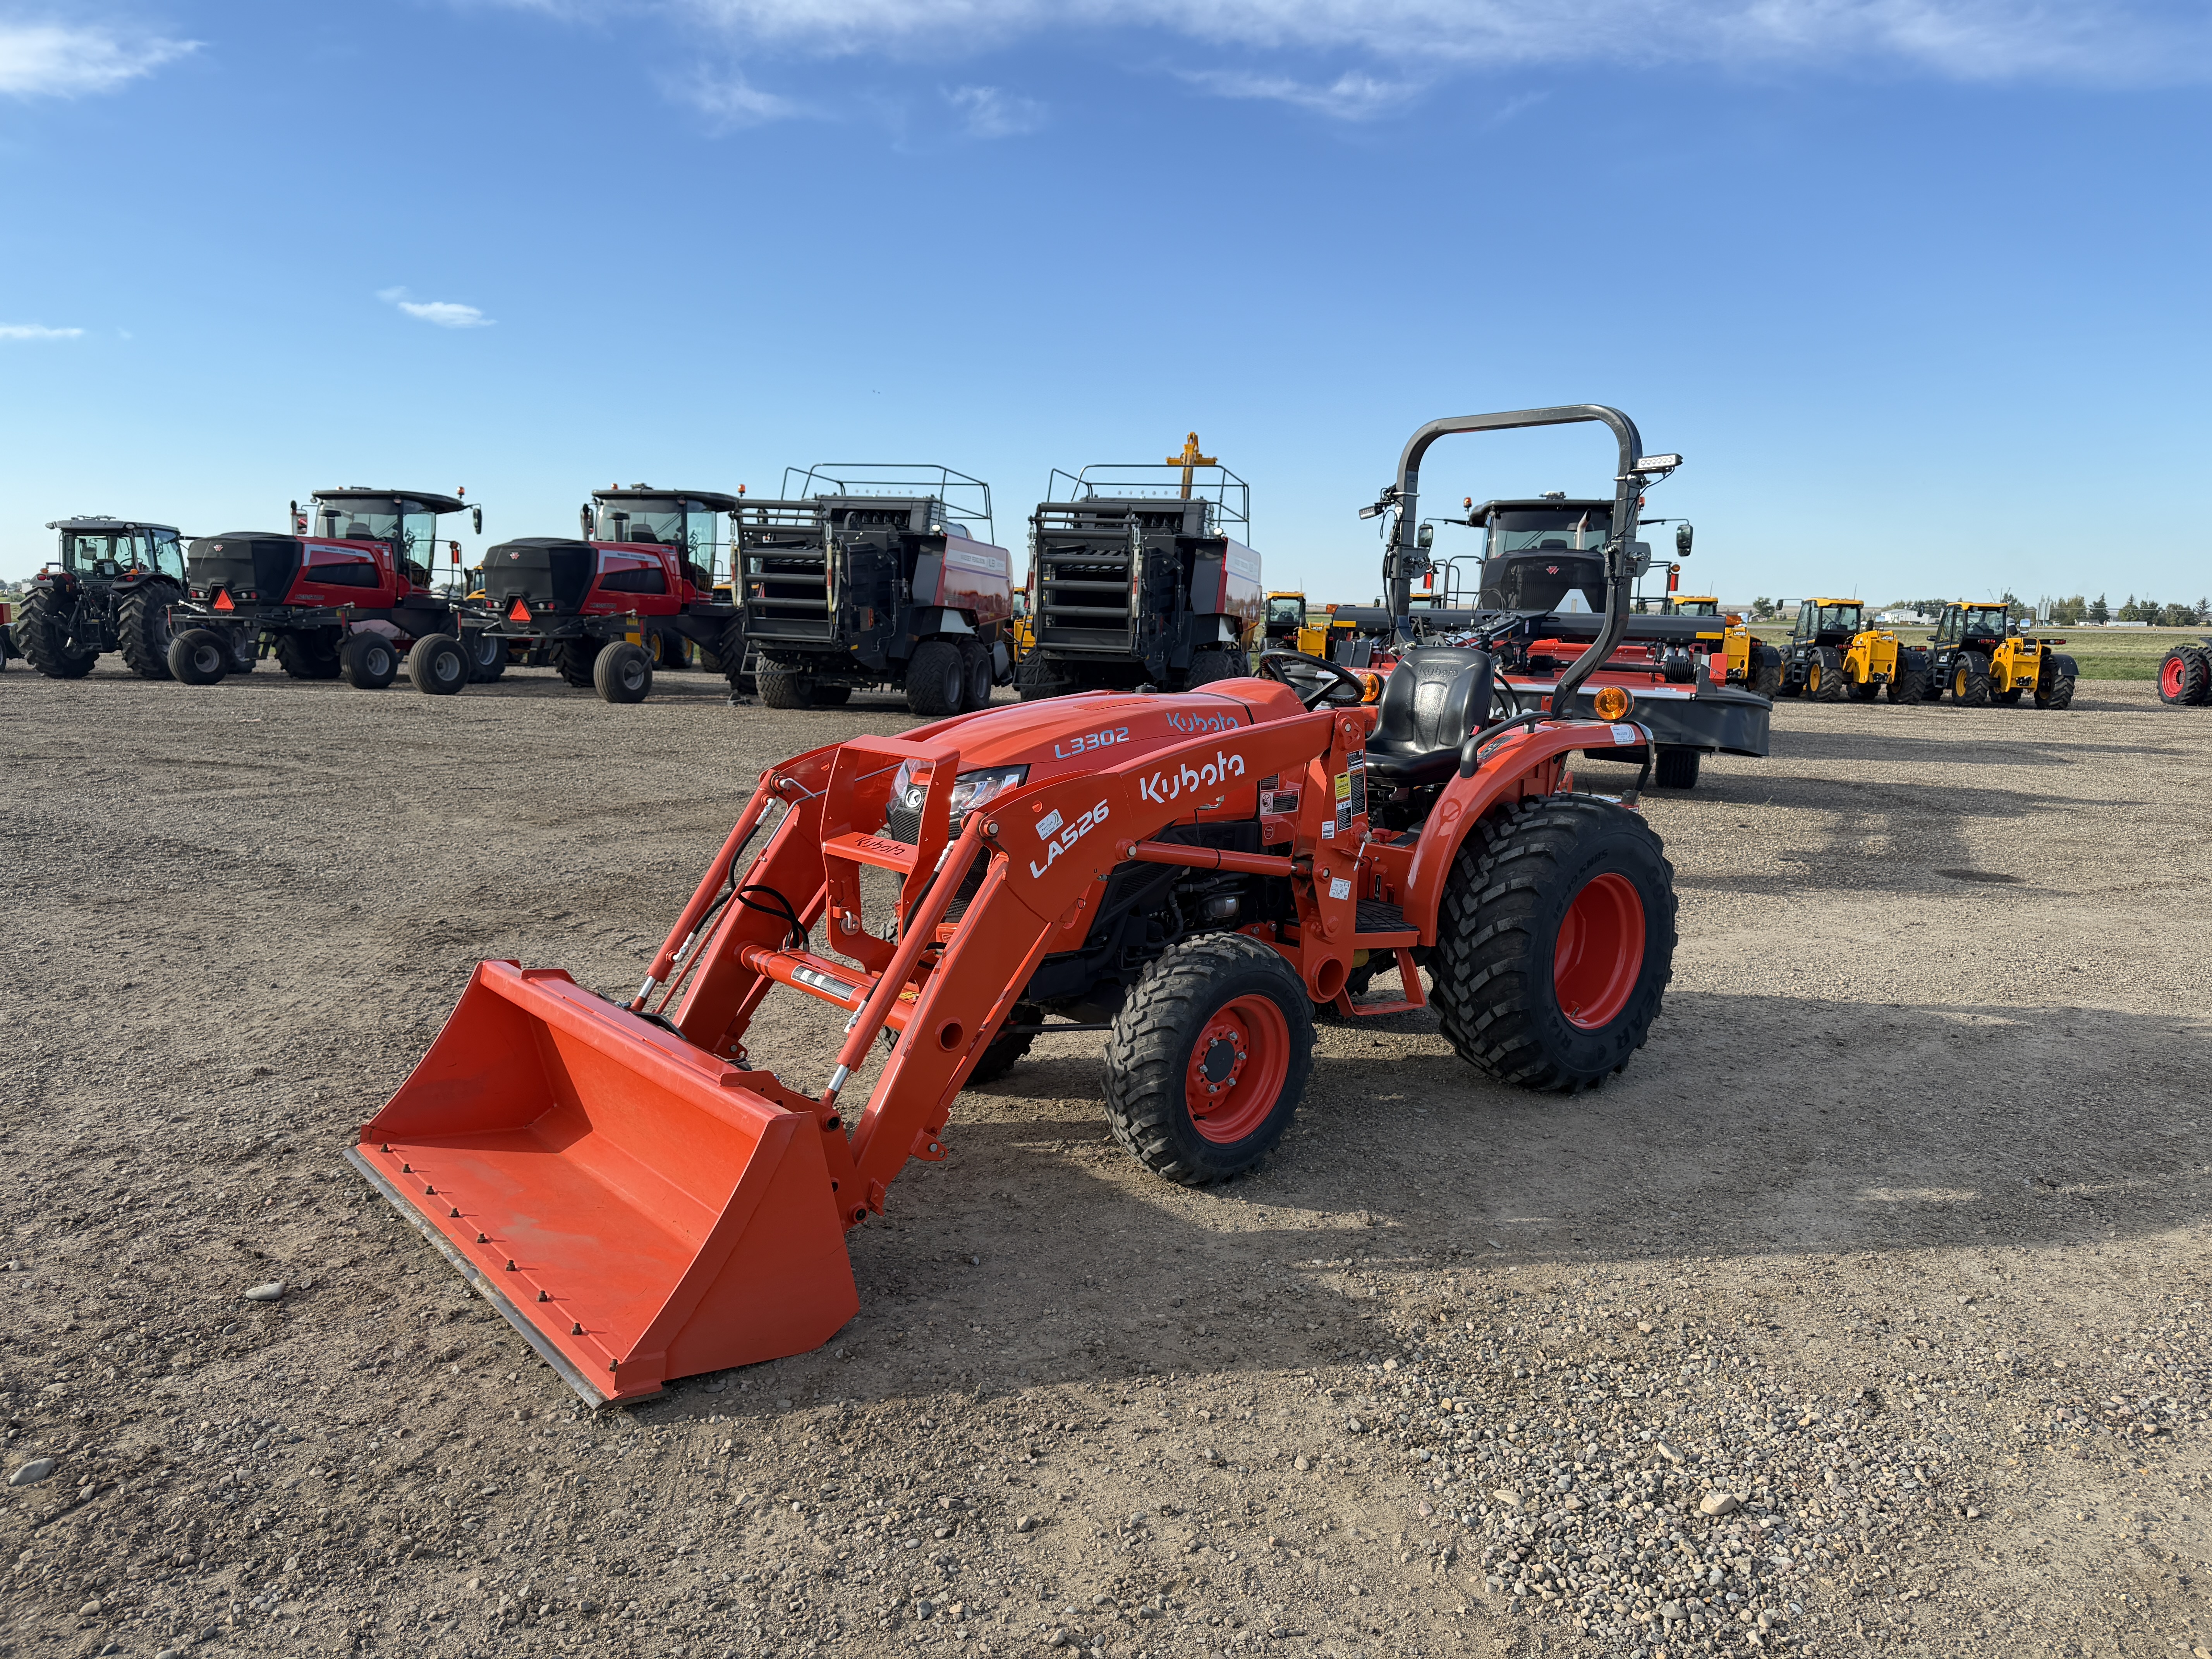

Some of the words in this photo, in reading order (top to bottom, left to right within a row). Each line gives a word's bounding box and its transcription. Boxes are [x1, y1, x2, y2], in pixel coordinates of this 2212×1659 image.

[1418, 666, 1458, 678] Kubota
[1166, 712, 1239, 732] Kubota
[1054, 726, 1130, 759] L3302
[1140, 750, 1245, 804] Kubota
[855, 835, 906, 856] Kubota
[1029, 798, 1110, 879] LA526
[1614, 866, 1671, 1050] GOODYEAR
